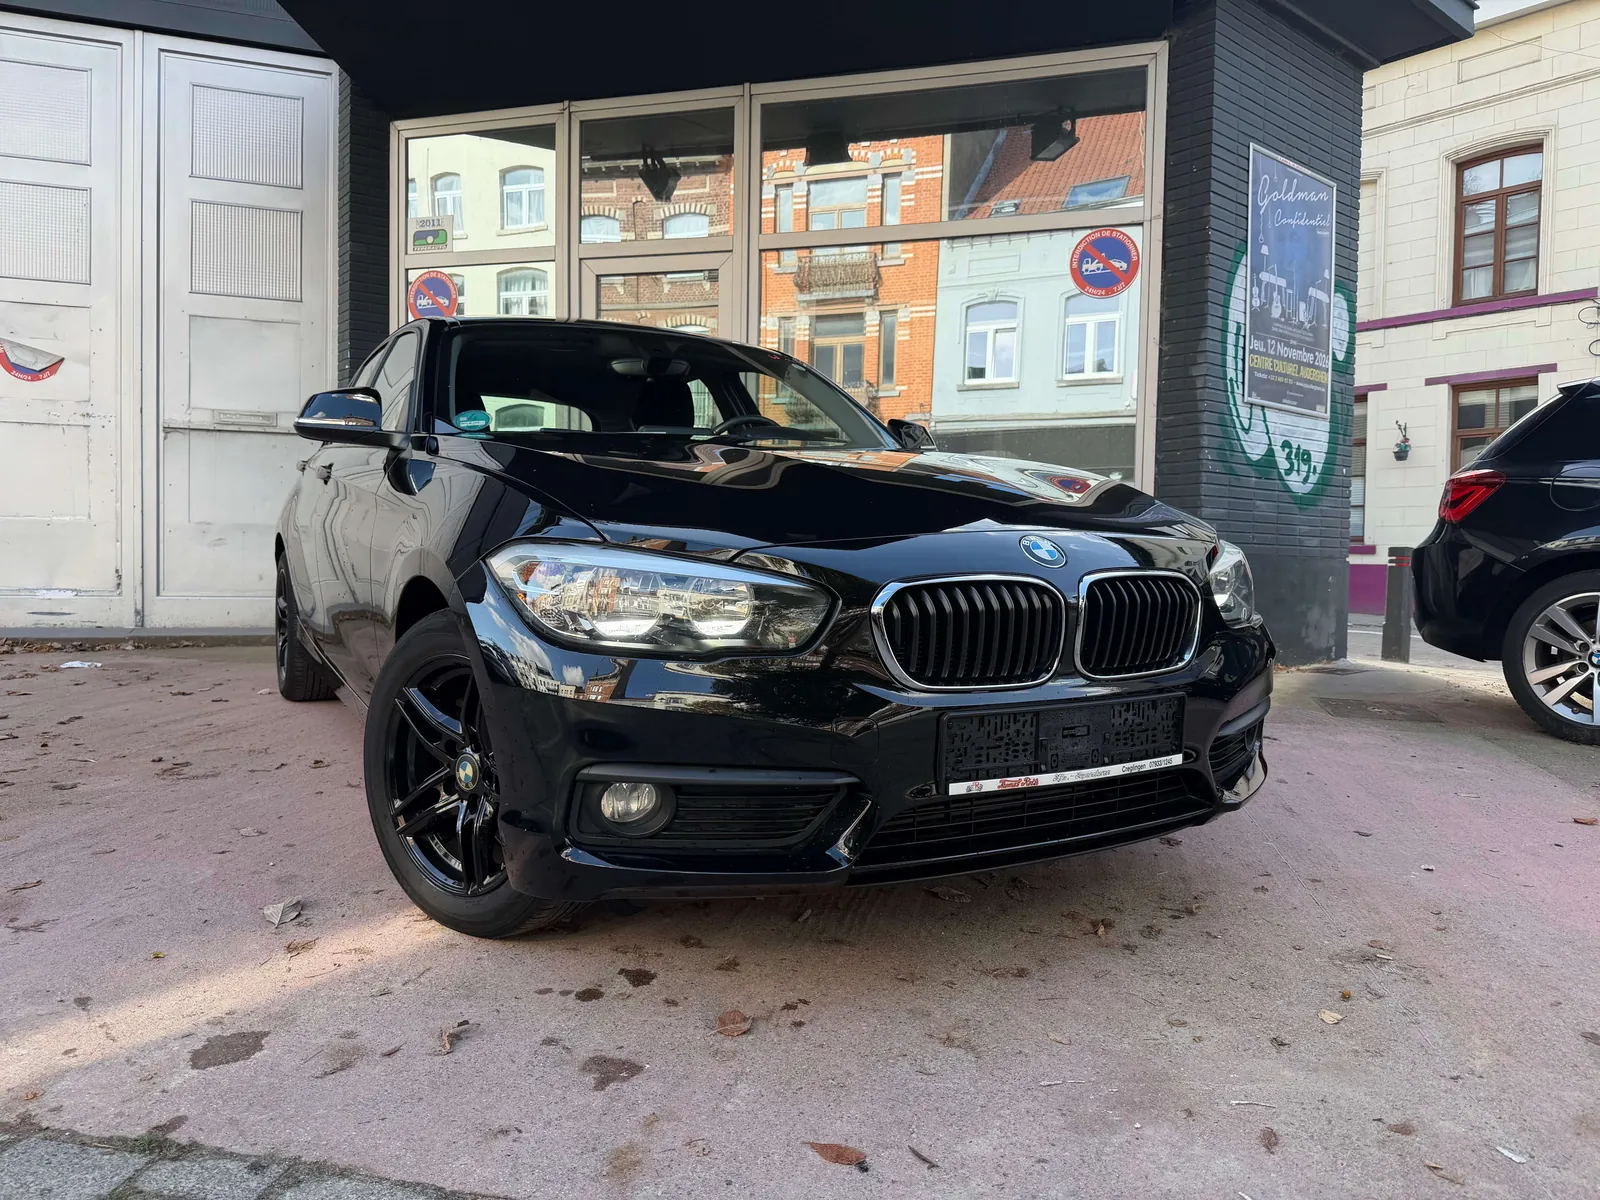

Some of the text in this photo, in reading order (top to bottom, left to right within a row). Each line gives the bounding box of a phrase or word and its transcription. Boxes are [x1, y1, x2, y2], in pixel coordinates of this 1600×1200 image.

[1258, 175, 1329, 214] Goldman
[420, 218, 441, 228] 2011
[1275, 209, 1331, 228] Confidentiel
[1072, 231, 1101, 269] INTERDICTION
[1111, 231, 1138, 261] STATIONNER
[1084, 285, 1106, 296] 24H/24
[1249, 335, 1266, 353] Jeu.
[1267, 339, 1276, 355] 12
[1276, 341, 1315, 364] Novembre
[11, 370, 32, 380] 24H/24
[1249, 354, 1273, 371] CENTRE
[1273, 359, 1299, 377] CULTUREL
[1121, 763, 1146, 773] Creglingen
